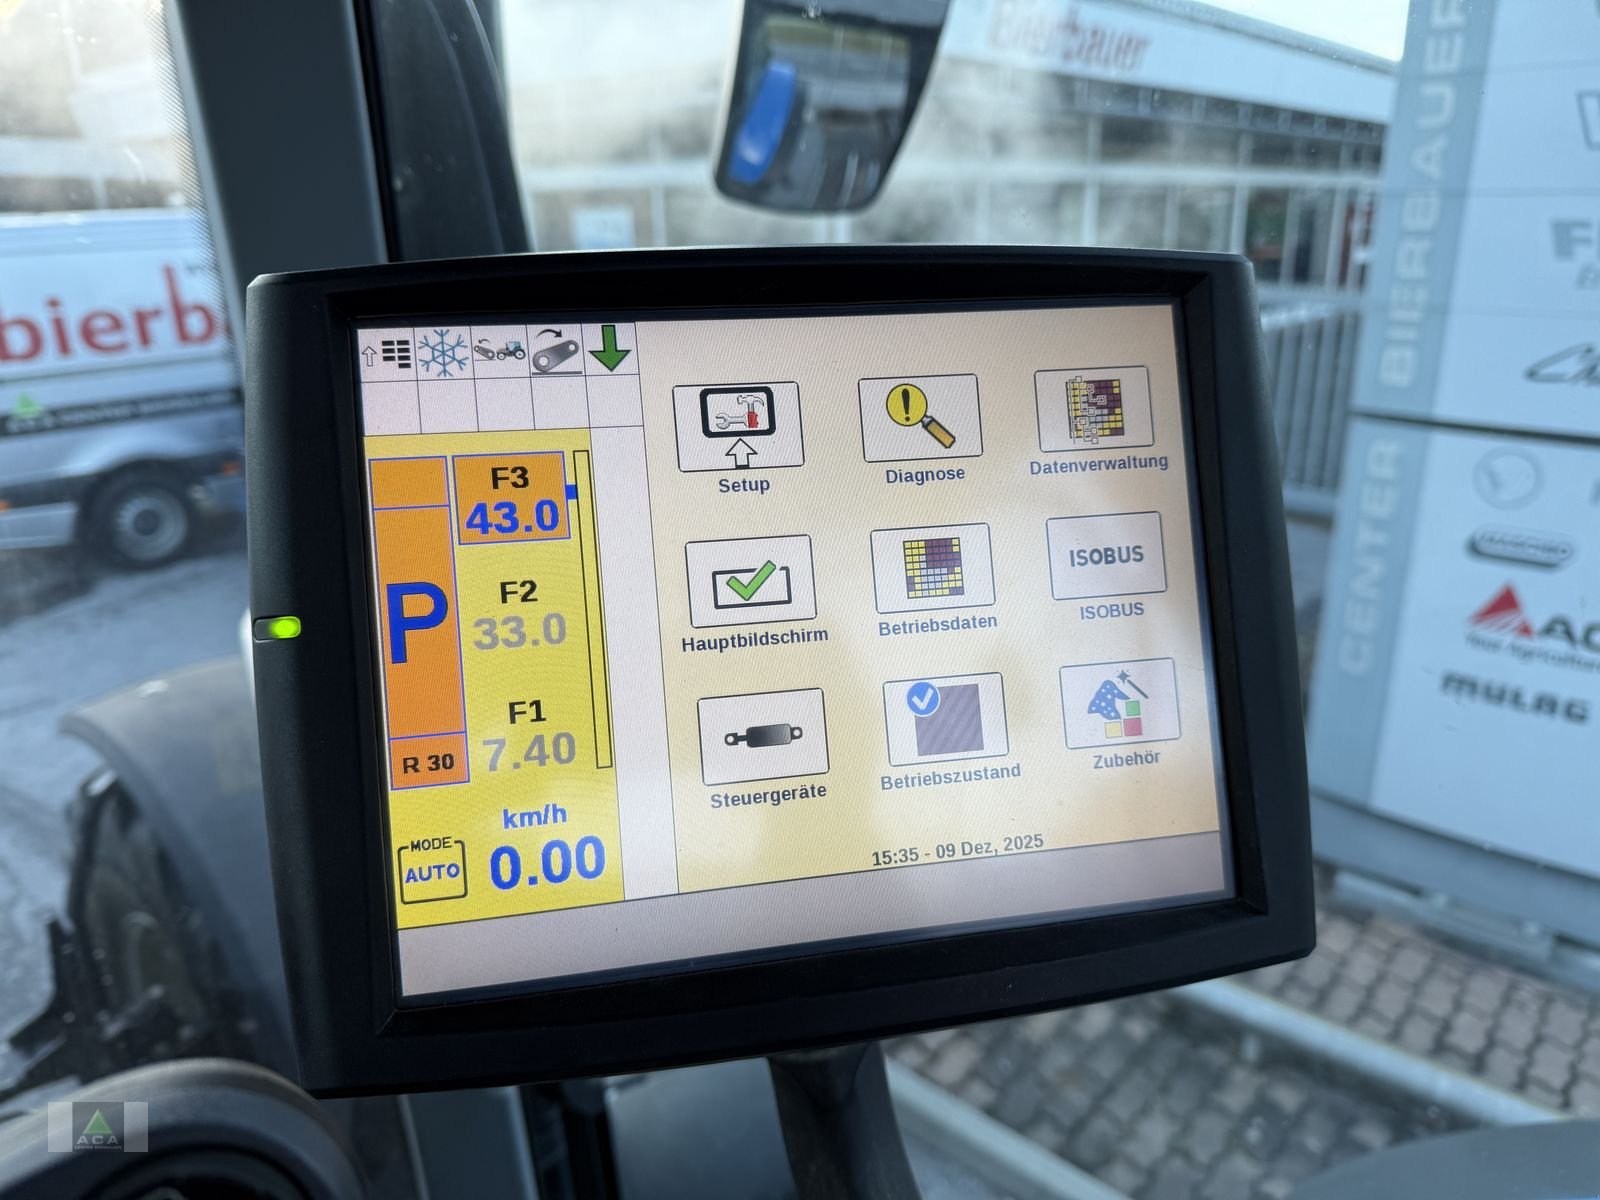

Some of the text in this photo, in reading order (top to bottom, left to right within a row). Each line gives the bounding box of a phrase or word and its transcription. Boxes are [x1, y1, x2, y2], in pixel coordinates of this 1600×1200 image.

[0, 264, 234, 362] bierb
[490, 466, 530, 490] F3
[885, 467, 966, 486] Diagnose
[1029, 455, 1169, 476] Datenverwaltung
[718, 478, 771, 495] Setup
[465, 499, 560, 535] 43.0
[1069, 545, 1145, 568] ISOBUS
[499, 579, 539, 604] F2
[386, 581, 449, 664] P
[1080, 602, 1145, 620] ISOBUS
[472, 612, 567, 651] 33.0
[878, 613, 998, 637] Betriebsdaten
[681, 628, 830, 653] Hauptbildschirm
[508, 699, 547, 725] F1
[402, 752, 455, 774] R 30
[482, 731, 577, 773] 7.40
[1093, 750, 1161, 770] Zubehör
[880, 763, 1022, 792] Betriebszustand
[710, 784, 828, 810] Steuergeräte
[502, 803, 568, 830] km/h
[409, 837, 452, 853] MODE
[872, 847, 920, 867] 15:35
[936, 843, 956, 859] 09
[961, 841, 999, 856] Dez,
[1003, 833, 1045, 851] 2025
[404, 862, 460, 884] AUTO
[490, 835, 606, 890] 0.00
